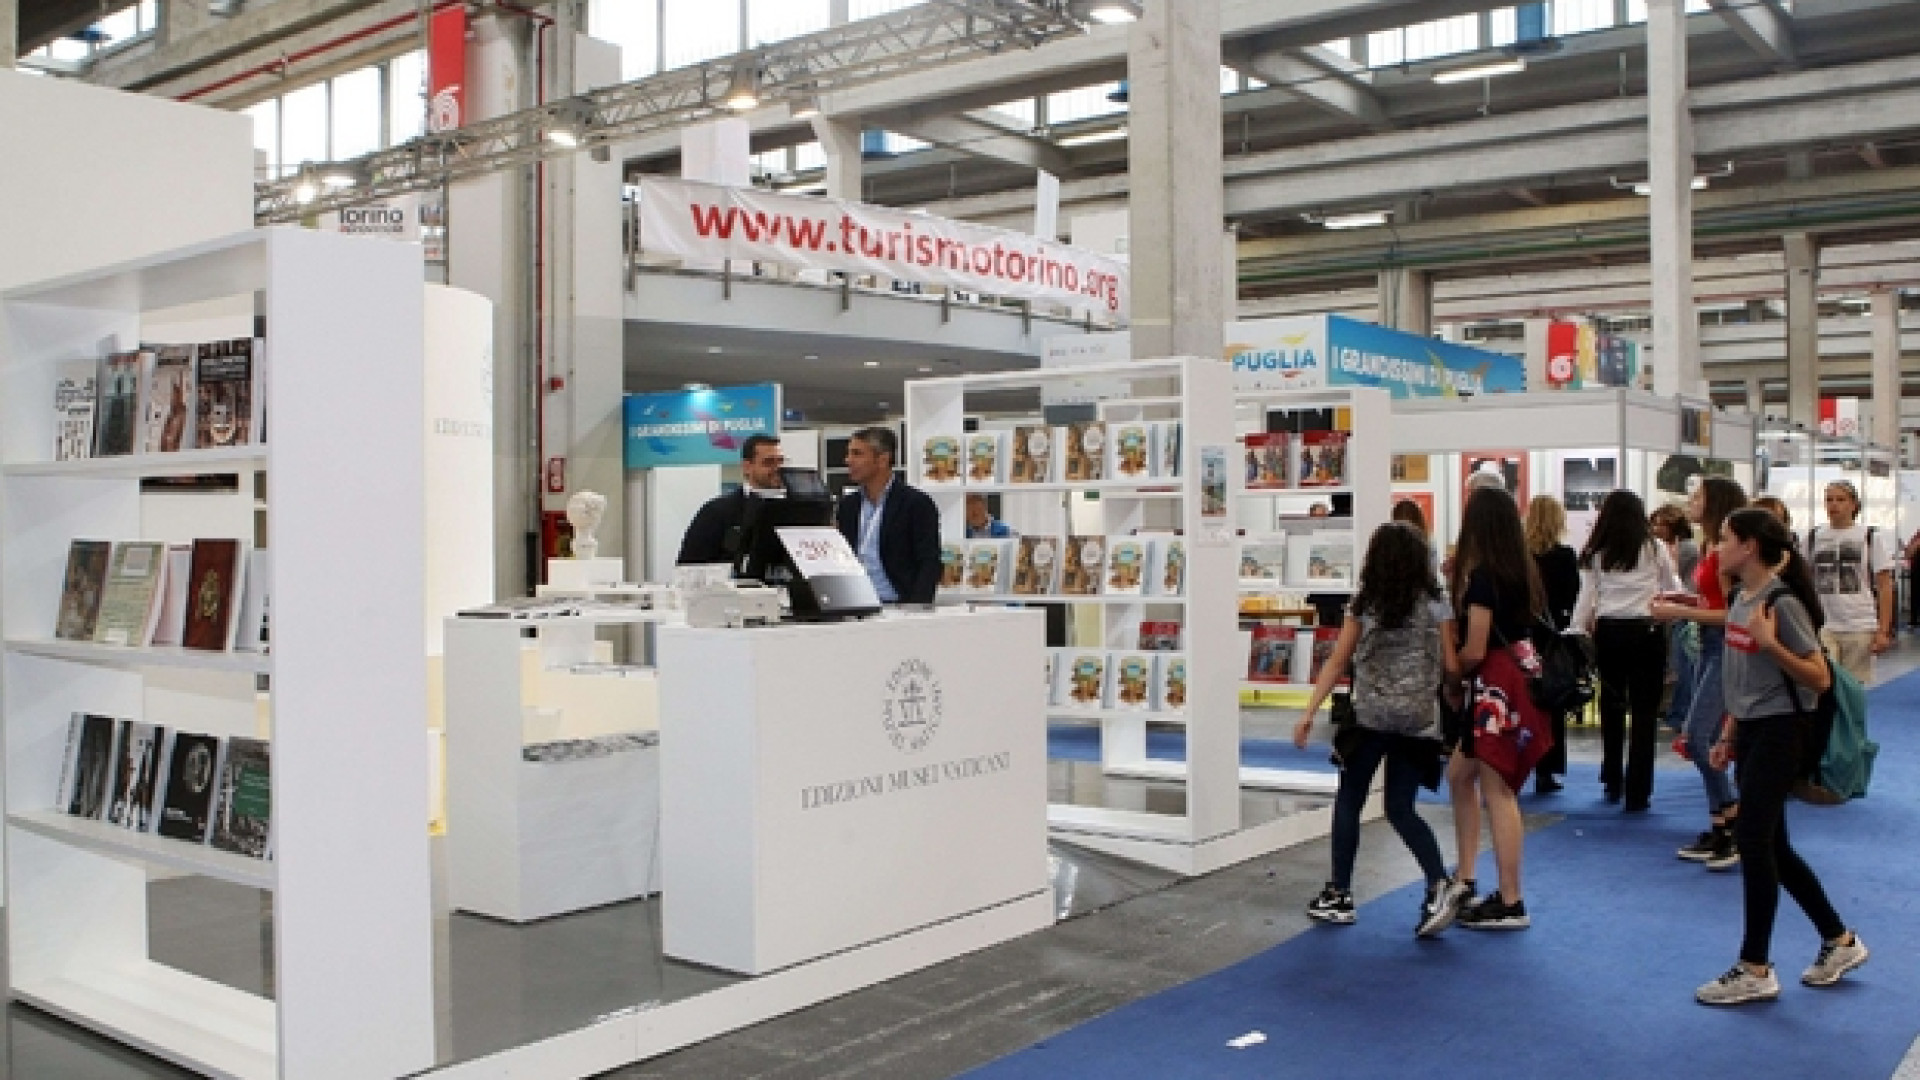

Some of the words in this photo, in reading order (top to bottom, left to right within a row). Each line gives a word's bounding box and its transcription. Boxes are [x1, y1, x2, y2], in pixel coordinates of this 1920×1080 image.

[690, 203, 1119, 310] www.turismotorino.org
[1231, 348, 1317, 371] PUGLIA
[724, 417, 766, 431] PUGLIA
[801, 773, 884, 811] EDIZIONI
[888, 763, 939, 792] MUSEI
[942, 751, 1011, 781] VATICANI
